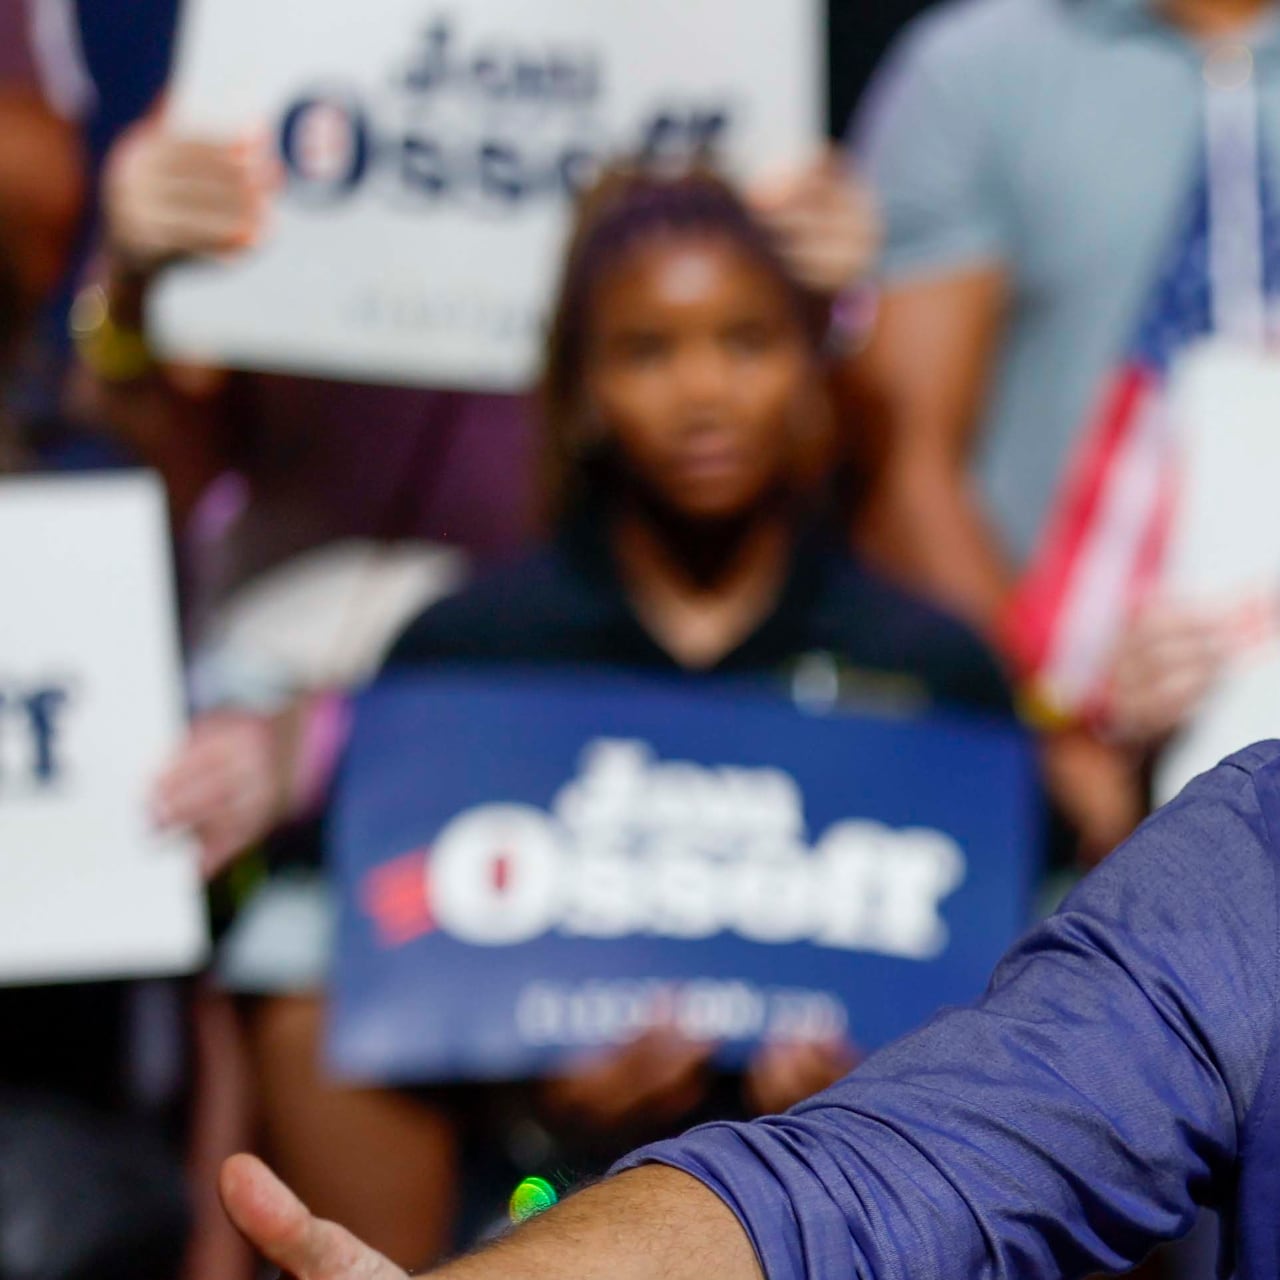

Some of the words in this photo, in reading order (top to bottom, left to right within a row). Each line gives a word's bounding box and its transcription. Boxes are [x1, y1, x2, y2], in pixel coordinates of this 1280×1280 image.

[398, 15, 604, 97] Jon
[556, 738, 803, 830] Jon
[427, 800, 966, 960] Ossoff
